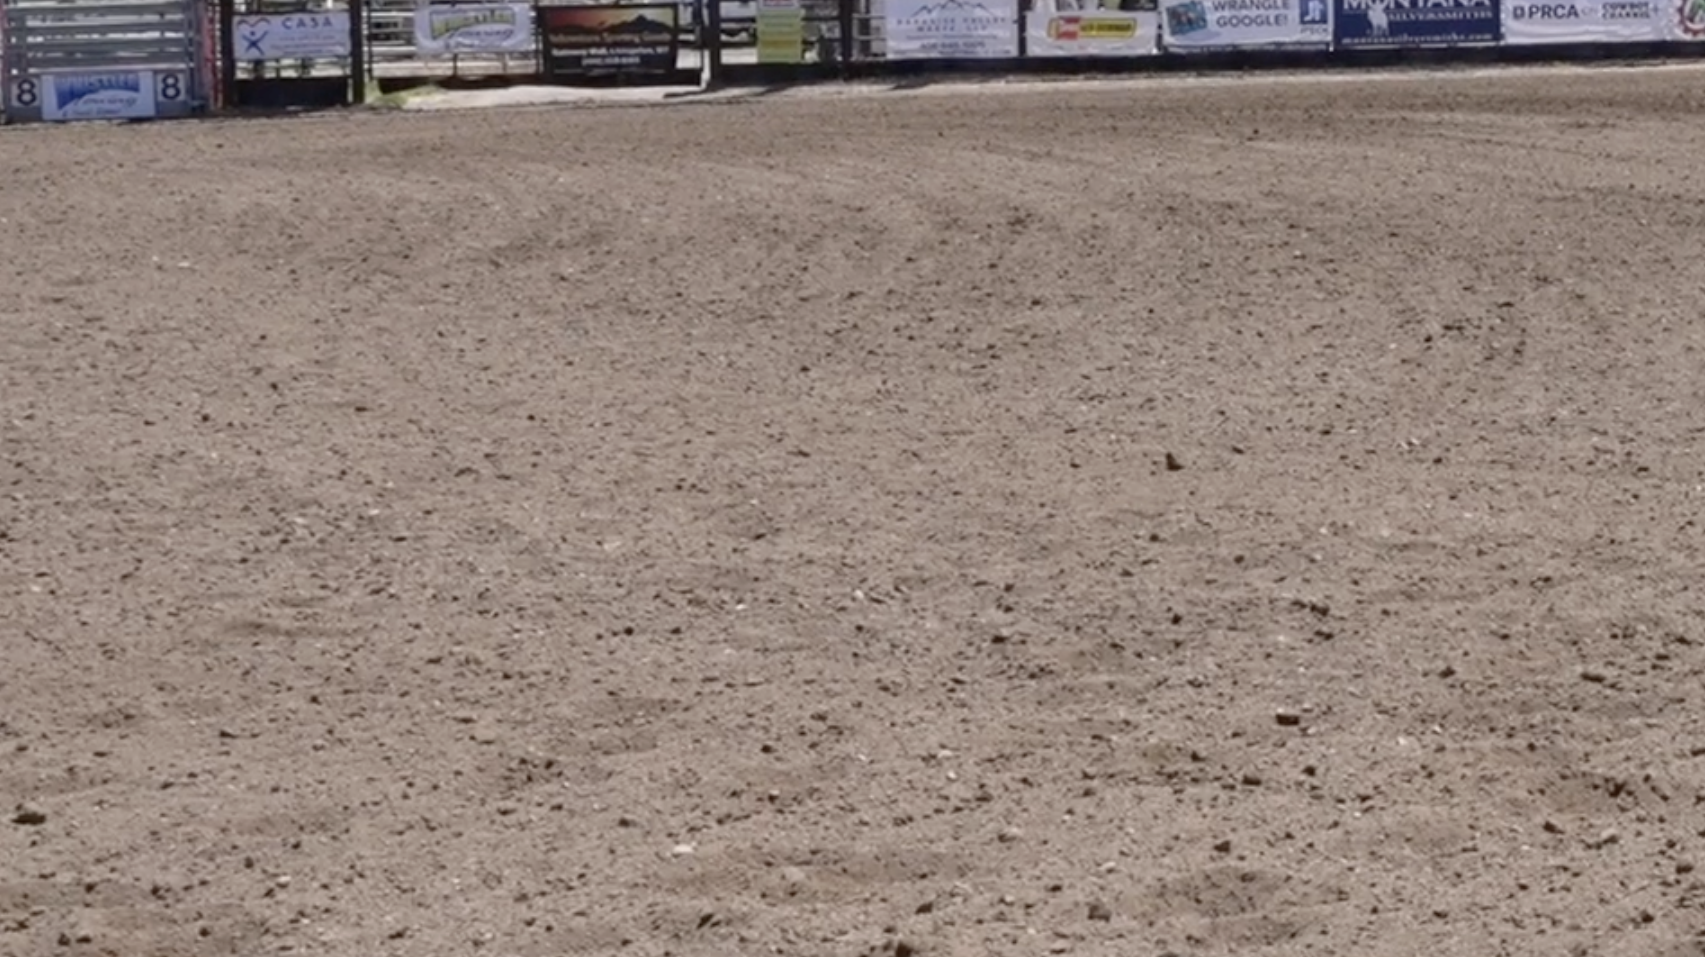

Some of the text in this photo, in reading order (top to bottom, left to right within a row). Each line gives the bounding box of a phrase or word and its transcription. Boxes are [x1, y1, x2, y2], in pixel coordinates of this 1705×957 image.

[1528, 3, 1580, 19] PRCA
[281, 15, 333, 31] CASA
[1216, 13, 1289, 28] GOOGLE!
[17, 78, 37, 106] 8
[161, 74, 181, 100] 8
